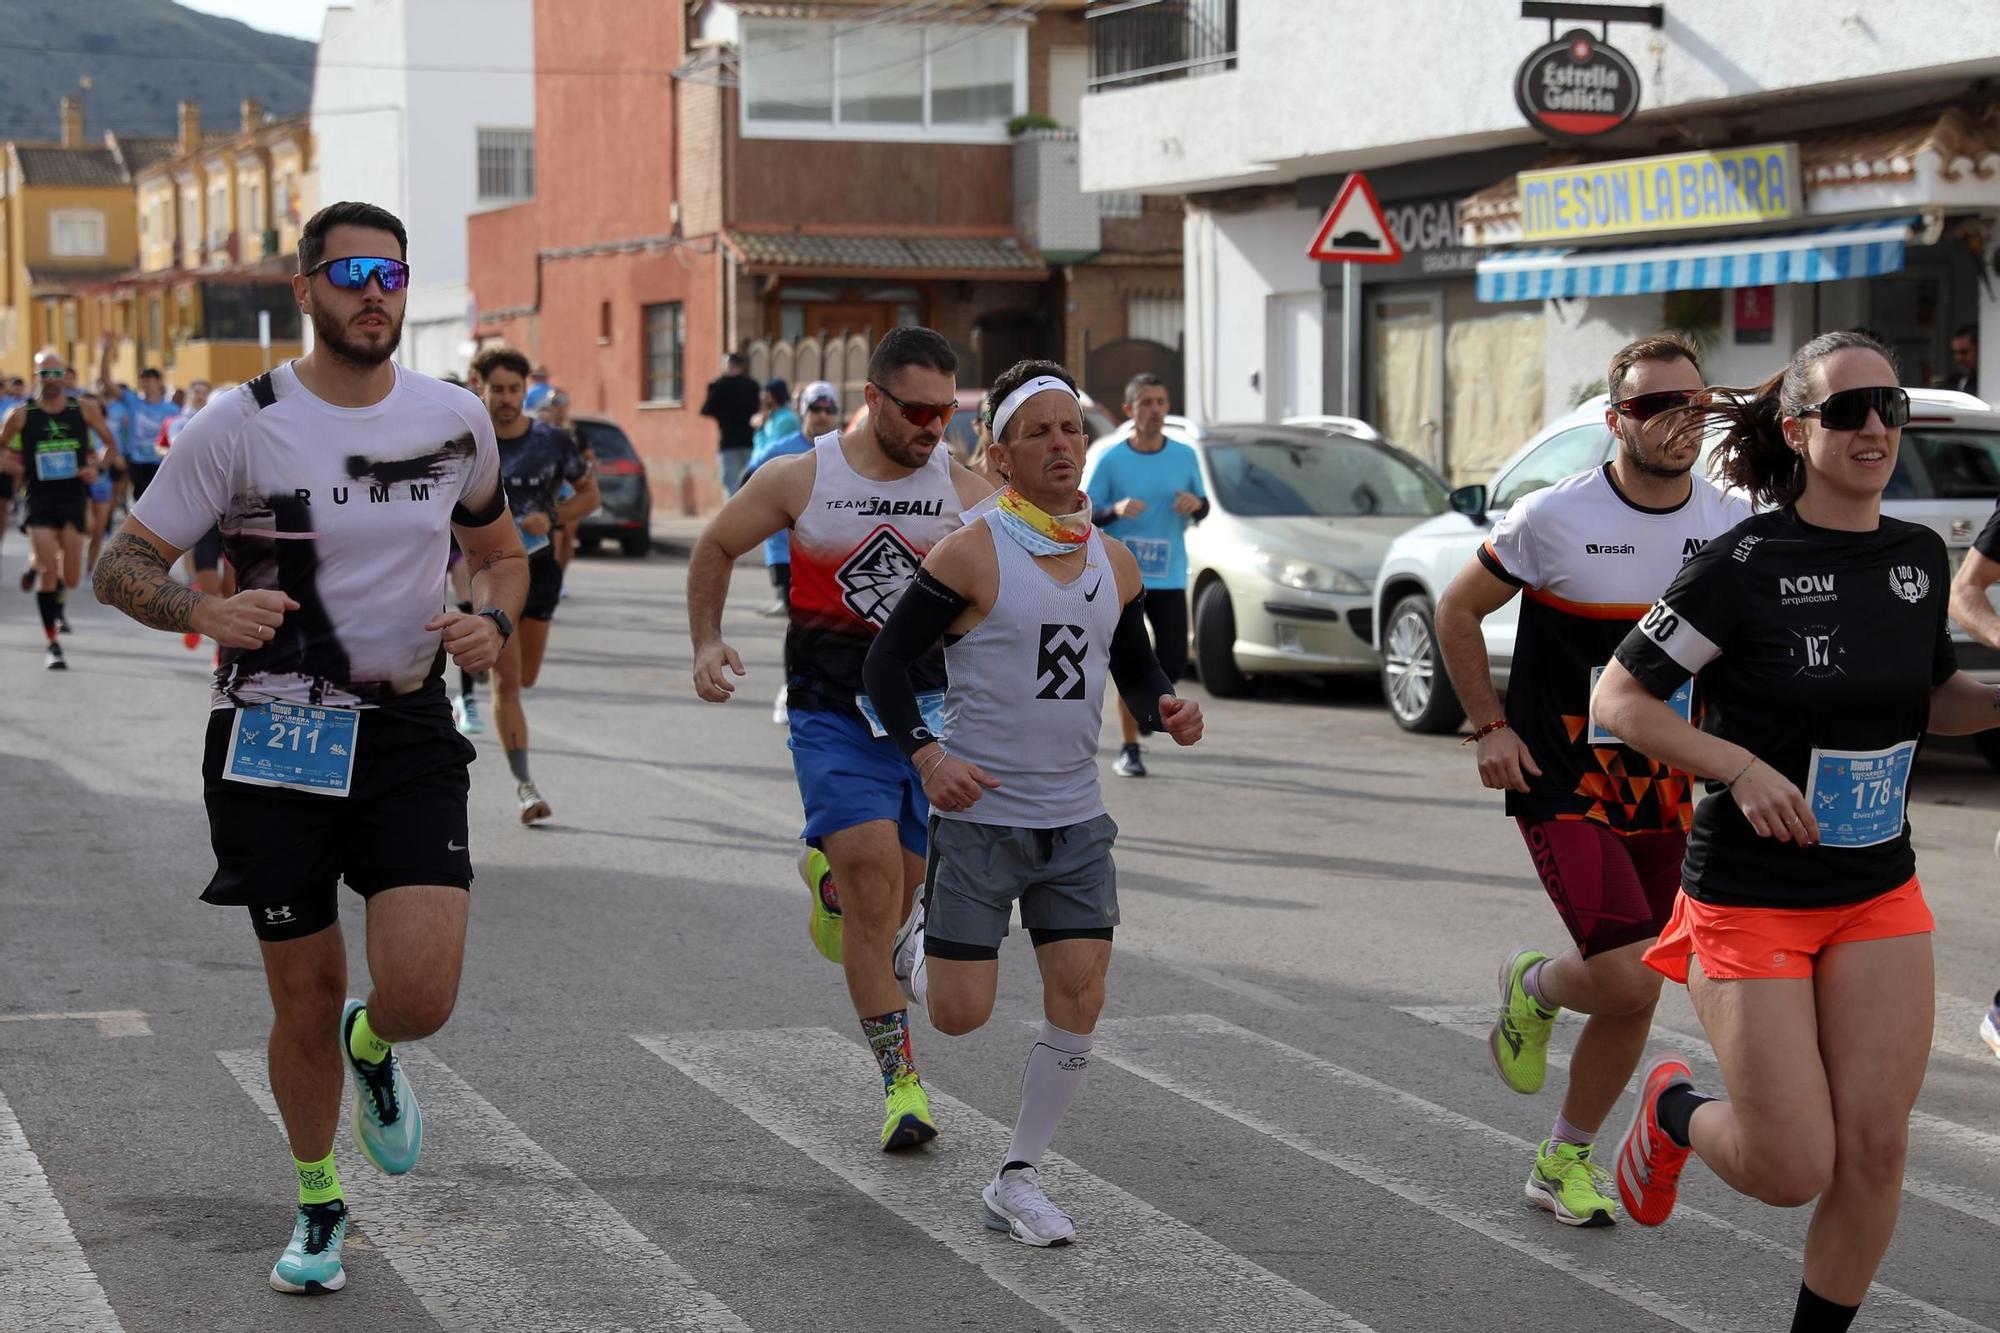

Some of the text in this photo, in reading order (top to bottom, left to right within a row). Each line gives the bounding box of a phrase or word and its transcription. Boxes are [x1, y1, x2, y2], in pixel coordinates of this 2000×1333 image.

[1542, 60, 1619, 88] Estrella
[1543, 86, 1615, 111] Galicia
[1525, 154, 1786, 232] MESON LA BARRA
[826, 500, 867, 510] TEAM
[1599, 544, 1635, 554] rasán
[1780, 574, 1835, 595] NOW
[1897, 565, 1913, 580] 100
[1781, 593, 1838, 606] arquitectura
[1804, 635, 1829, 667] B7
[266, 722, 320, 754] 211
[1851, 778, 1892, 810] 178
